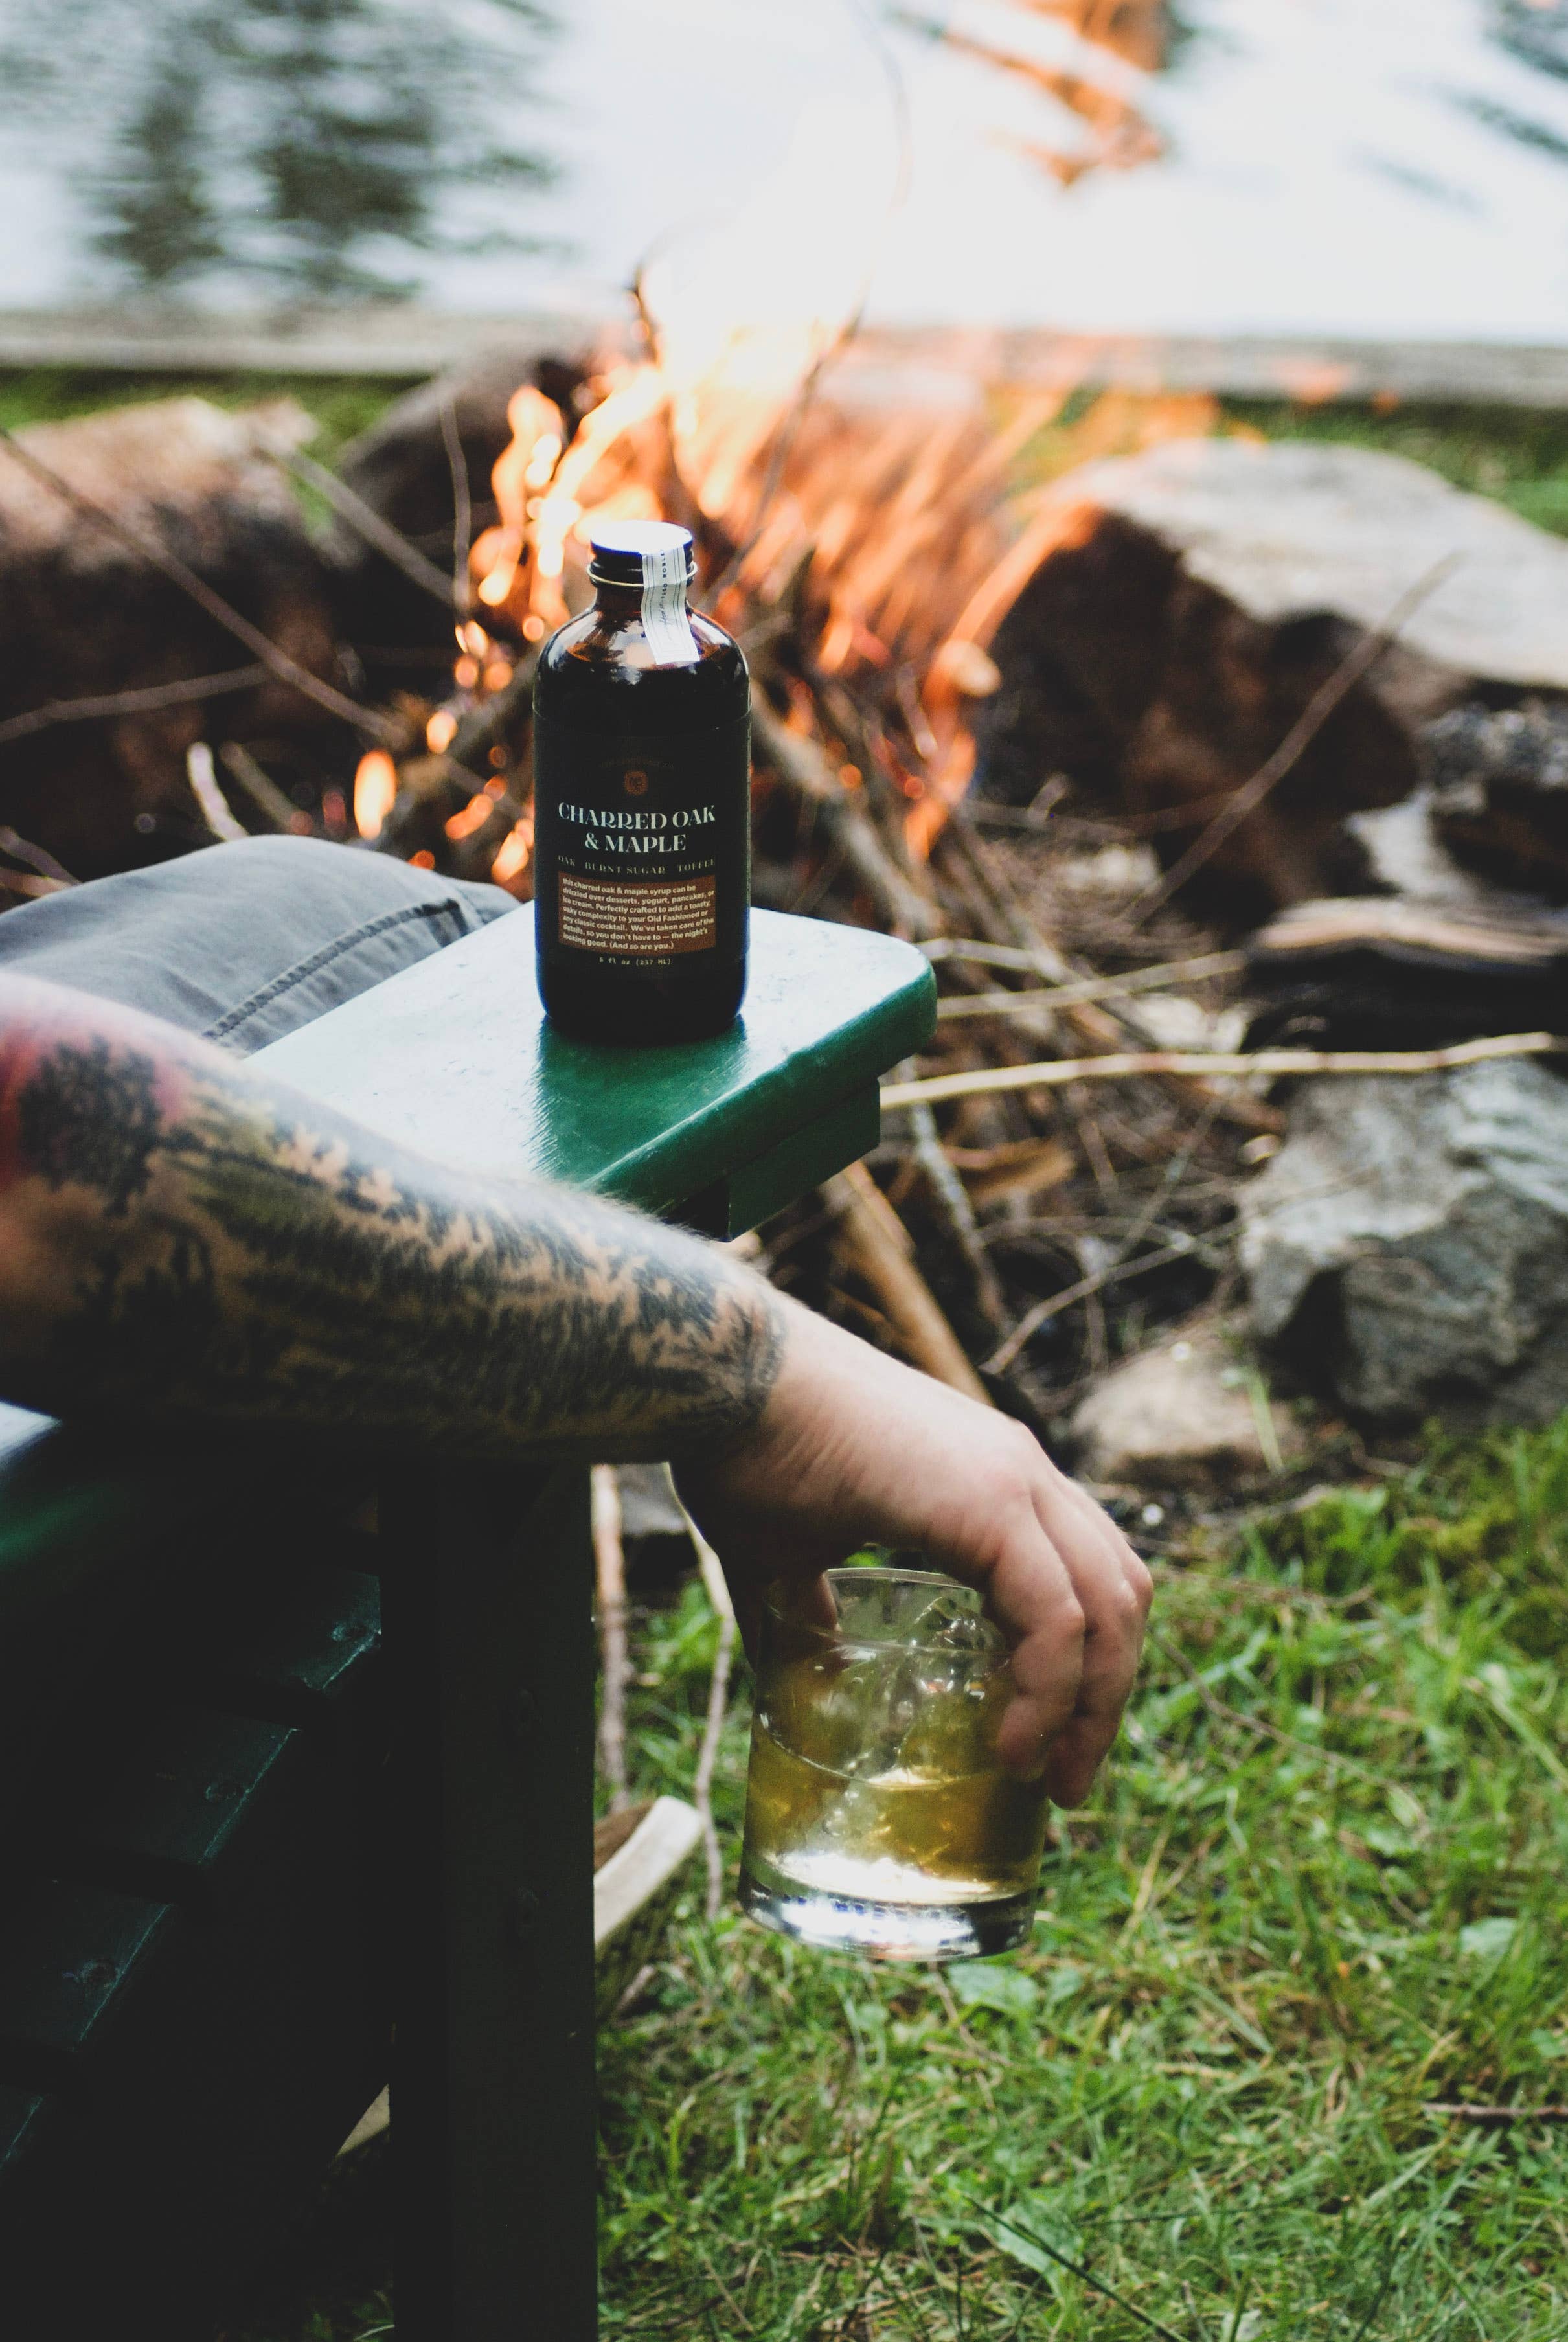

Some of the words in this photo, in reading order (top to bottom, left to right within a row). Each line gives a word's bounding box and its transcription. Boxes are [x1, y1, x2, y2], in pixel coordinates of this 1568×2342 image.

[559, 802, 667, 830] CHARRED
[672, 805, 716, 828] OAK
[585, 832, 600, 850] &
[605, 834, 686, 853] MAPLE
[558, 855, 575, 866] OAK
[585, 861, 622, 874] BURNT
[678, 859, 716, 872] TOFFEE
[574, 881, 600, 891] charred
[563, 887, 587, 898] drizzled
[606, 896, 640, 904] desserts,
[671, 893, 706, 904] pancakes,
[563, 906, 577, 916] oaky
[578, 910, 617, 922] complexity
[663, 911, 700, 922] Fashioned
[572, 900, 593, 909] cream.
[595, 904, 628, 913] Perfectly
[689, 900, 711, 909] toasty,
[563, 924, 585, 936] details,
[685, 928, 708, 938] night's
[574, 918, 595, 928] classic
[597, 922, 628, 931] cocktail.
[563, 932, 586, 945] looking
[654, 941, 674, 951] you.)
